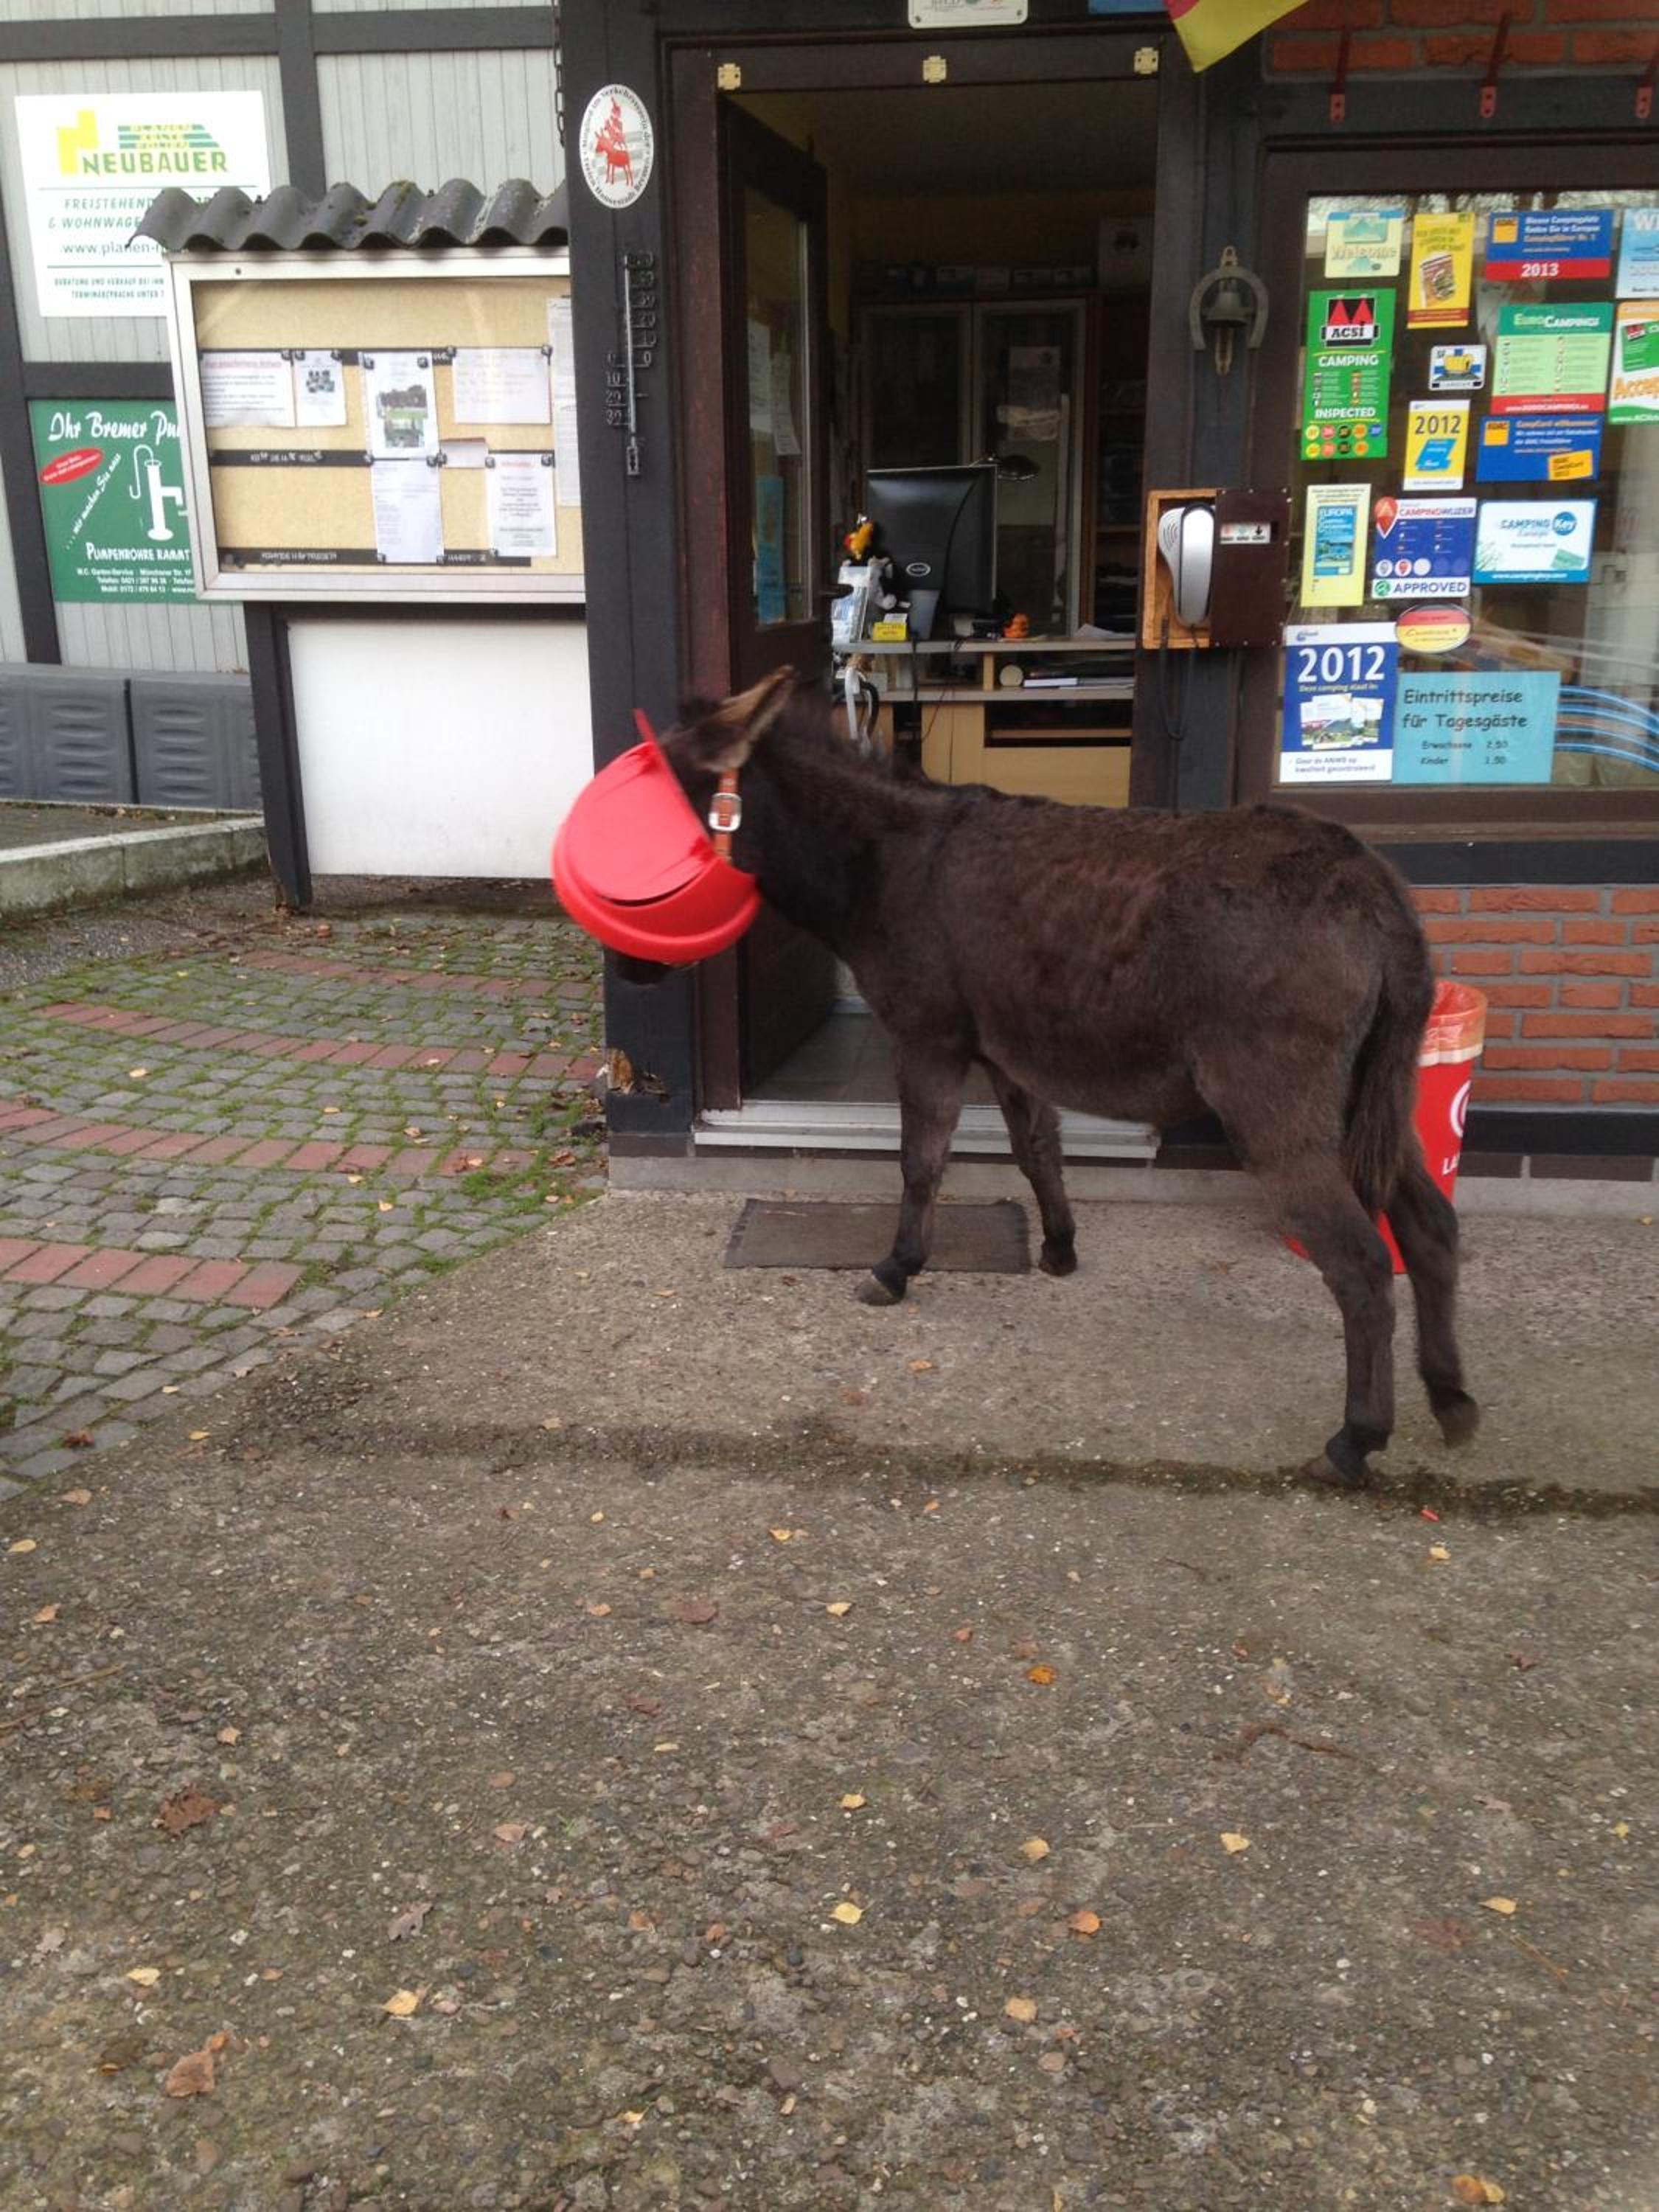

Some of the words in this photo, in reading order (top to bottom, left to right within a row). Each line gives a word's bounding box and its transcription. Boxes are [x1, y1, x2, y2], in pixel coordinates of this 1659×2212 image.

[82, 151, 229, 176] NEUBAUER
[1332, 246, 1398, 260] Welcome
[1520, 262, 1559, 278] 2013
[1318, 354, 1380, 367] CAMPING
[1314, 407, 1377, 420] INSPECTED
[86, 411, 147, 439] Bremer
[1415, 415, 1461, 435] 2012
[1499, 518, 1551, 530] CAMPING
[1393, 582, 1468, 594] APPROVED
[1297, 644, 1385, 683] 2012
[1403, 689, 1523, 707] Eintrittspreise
[1402, 713, 1428, 729] für
[1435, 713, 1528, 731] Tagesgäste
